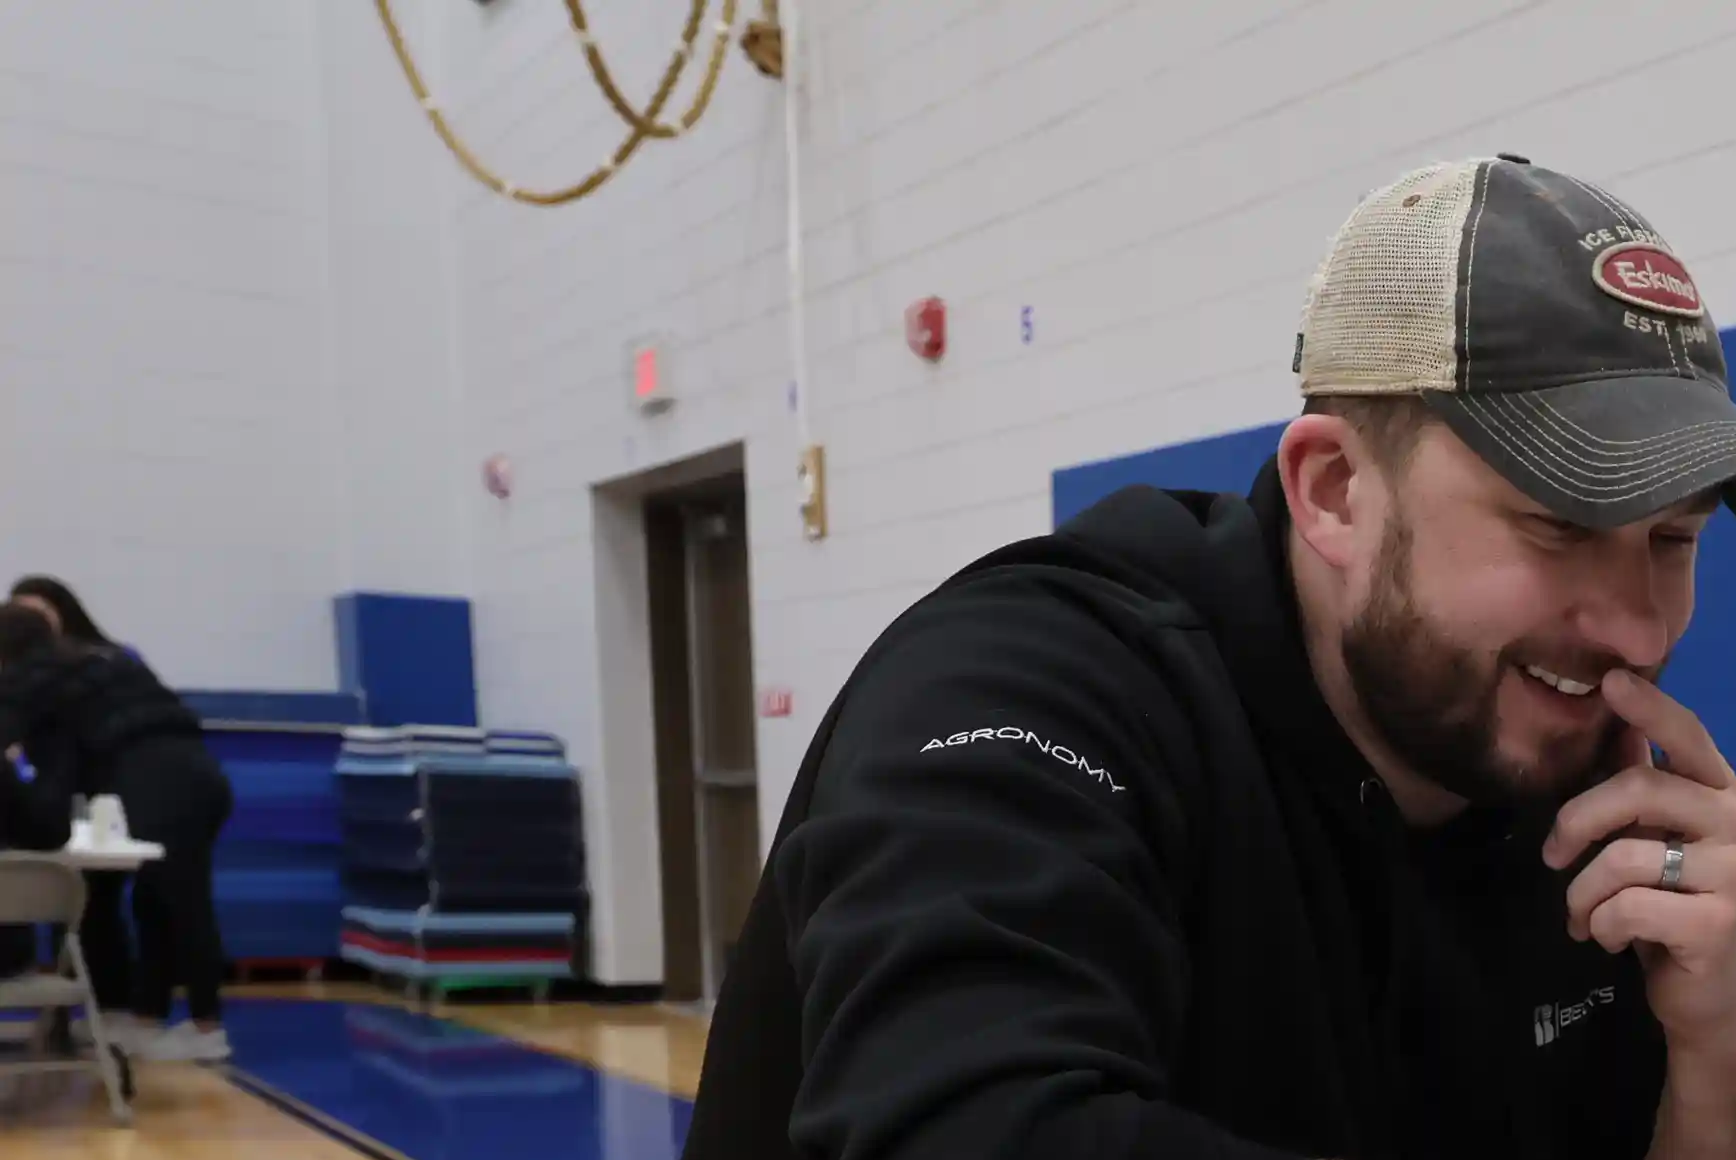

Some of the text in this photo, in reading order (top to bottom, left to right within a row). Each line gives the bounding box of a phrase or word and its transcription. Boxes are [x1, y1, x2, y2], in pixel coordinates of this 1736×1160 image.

[1578, 228, 1616, 251] ICE
[1614, 260, 1696, 302] Eskimo
[920, 727, 1126, 792] AGRONOMY
